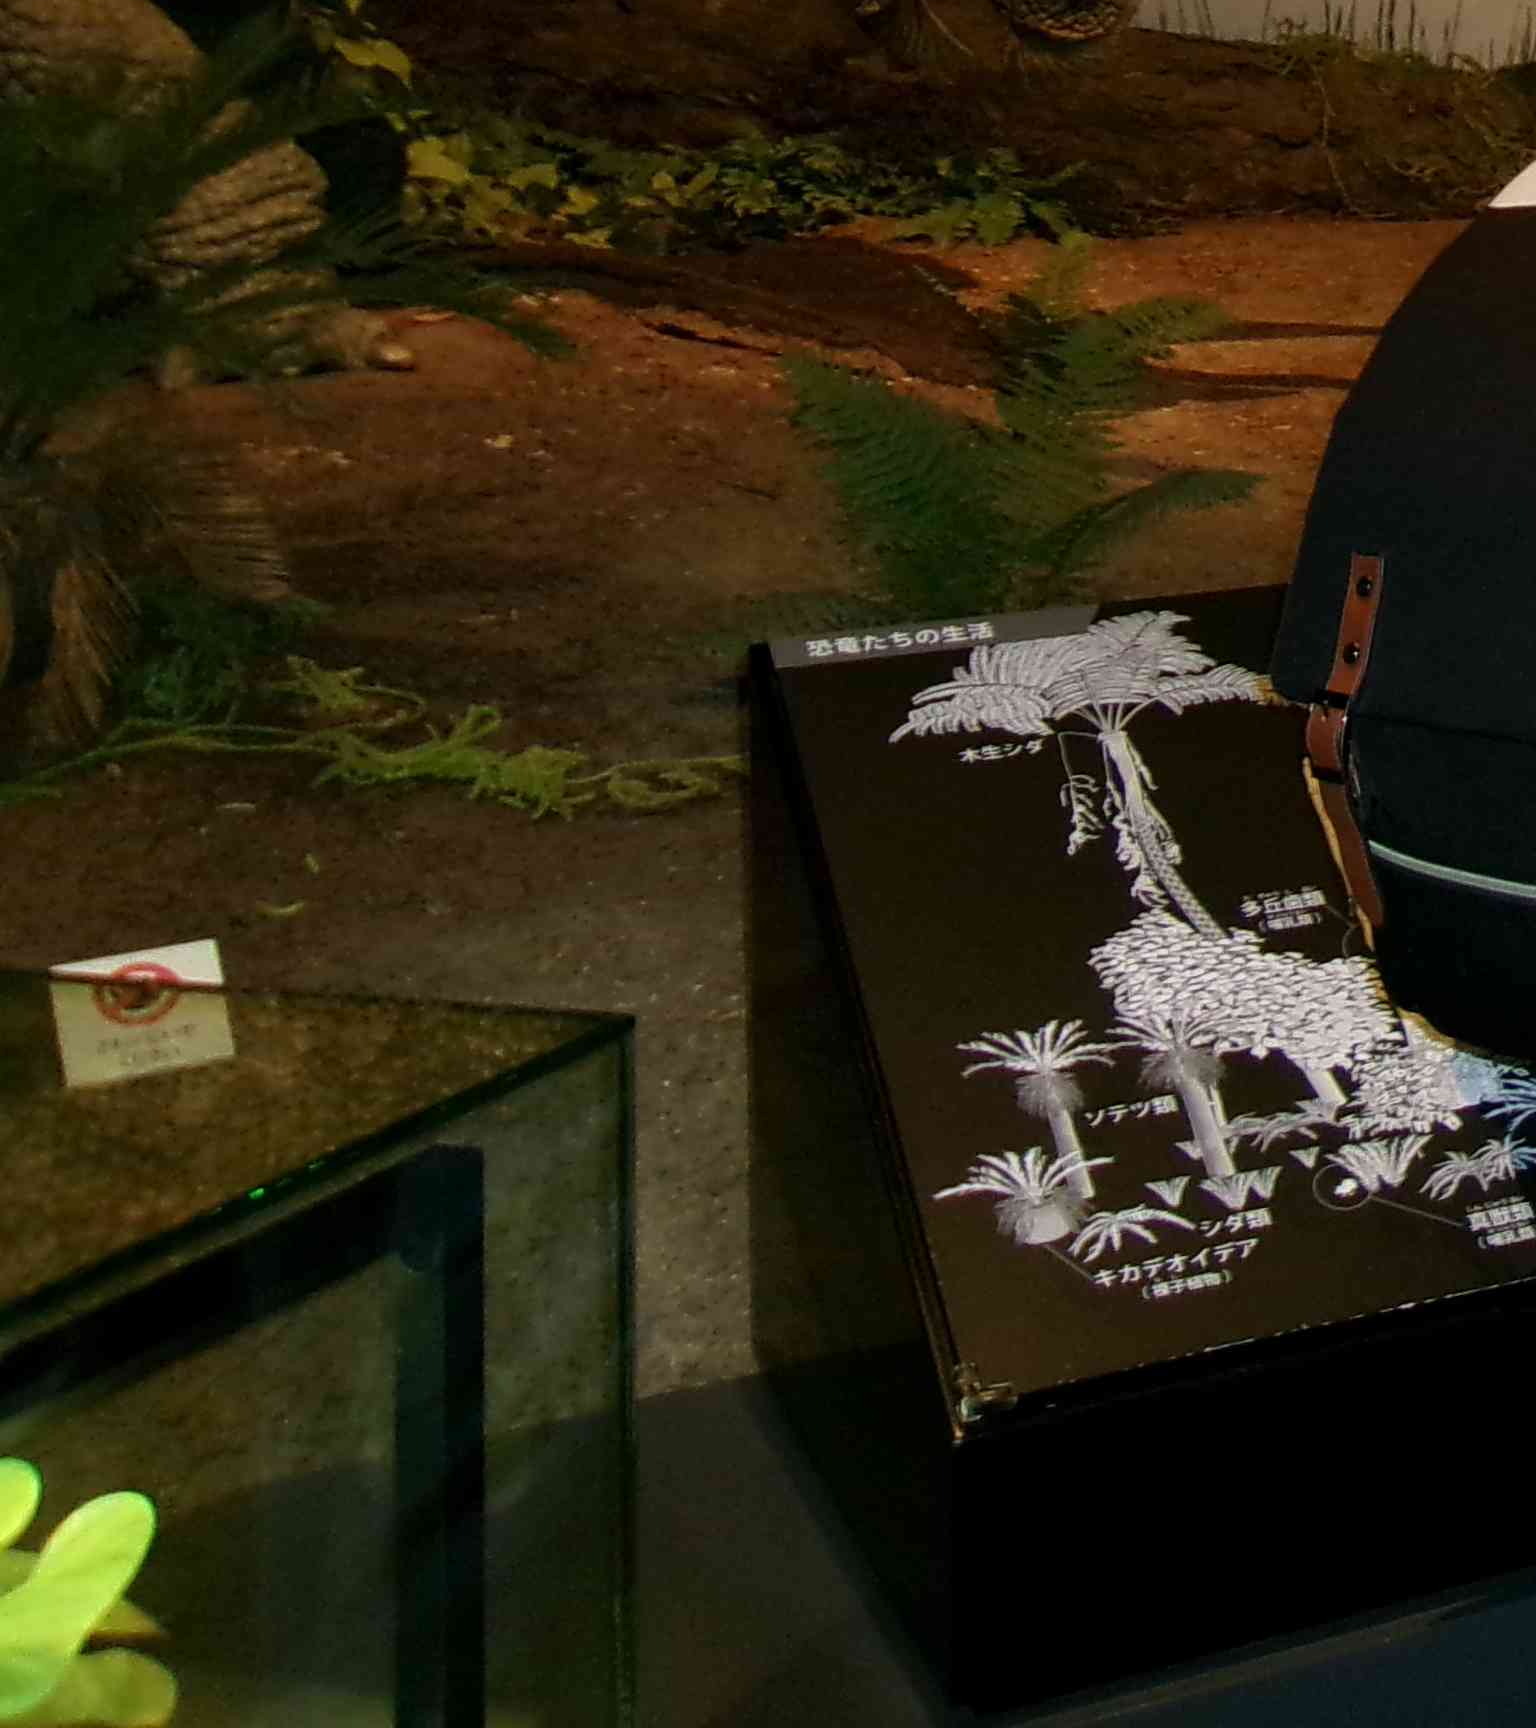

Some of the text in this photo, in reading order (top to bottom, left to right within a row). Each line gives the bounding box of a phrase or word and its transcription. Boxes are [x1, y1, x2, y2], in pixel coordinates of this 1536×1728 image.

[805, 621, 993, 657] 恐竜たちの生活
[959, 738, 1044, 764] 木生シダ
[1084, 1094, 1180, 1128] ソテツ類
[1199, 1207, 1273, 1238] シダ類
[1092, 1238, 1259, 1288] キカデオイデア
